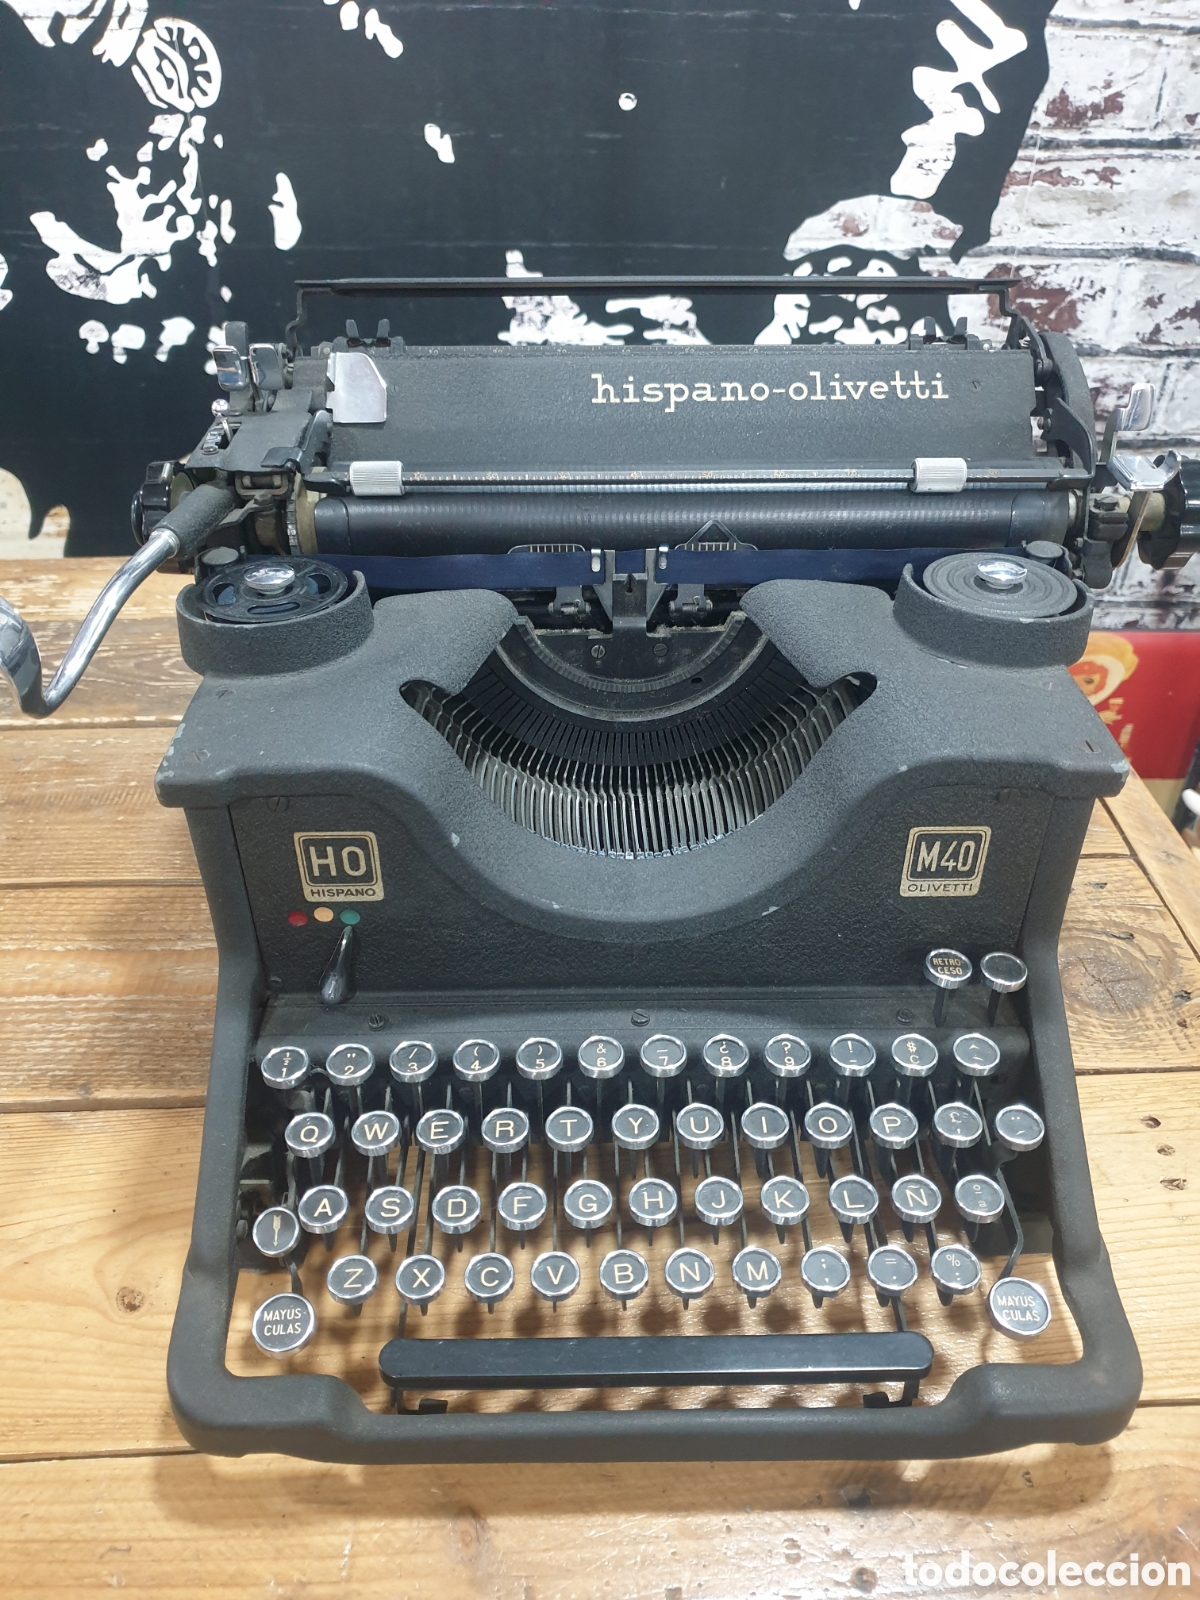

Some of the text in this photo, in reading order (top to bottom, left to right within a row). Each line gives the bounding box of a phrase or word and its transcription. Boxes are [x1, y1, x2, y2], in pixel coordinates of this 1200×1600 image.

[590, 370, 949, 413] hispano-olivetti
[309, 845, 367, 877] HO
[916, 840, 976, 873] M40
[310, 888, 376, 898] HISPANO
[907, 883, 974, 893] OLIVETTI
[937, 966, 963, 976] CESO
[596, 1042, 607, 1054] &
[781, 1041, 792, 1054] ?
[906, 1040, 917, 1054] $
[281, 1067, 287, 1078] 1
[344, 1065, 355, 1076] 2
[407, 1062, 418, 1073] 3
[470, 1059, 482, 1071] 4
[535, 1058, 545, 1069] 5
[596, 1057, 607, 1068] 6
[658, 1056, 669, 1067] 7
[721, 1056, 732, 1067] 8
[784, 1056, 795, 1067] 9
[300, 1125, 319, 1143] Q
[364, 1121, 390, 1141] W
[430, 1121, 450, 1140] E
[495, 1120, 514, 1138] R
[559, 1119, 578, 1137] T
[628, 1117, 643, 1135] Y
[689, 1116, 710, 1134] U
[761, 1115, 768, 1134] I
[818, 1116, 838, 1134] O
[882, 1116, 901, 1134] P
[313, 1197, 332, 1217] A
[380, 1197, 400, 1218] S
[447, 1198, 467, 1218] D
[513, 1196, 533, 1215] F
[578, 1193, 598, 1213] G
[643, 1190, 664, 1210] H
[711, 1189, 725, 1209] J
[774, 1189, 795, 1209] K
[843, 1190, 865, 1209] L
[905, 1184, 928, 1208] Ñ
[343, 1267, 364, 1288] Z
[412, 1267, 431, 1288] X
[480, 1266, 500, 1287] C
[546, 1264, 565, 1285] V
[613, 1263, 634, 1284] B
[679, 1261, 701, 1282] N
[746, 1260, 769, 1281] M
[945, 1253, 961, 1267] %
[1002, 1309, 1041, 1322] CULAS
[263, 1322, 302, 1337] CULAS
